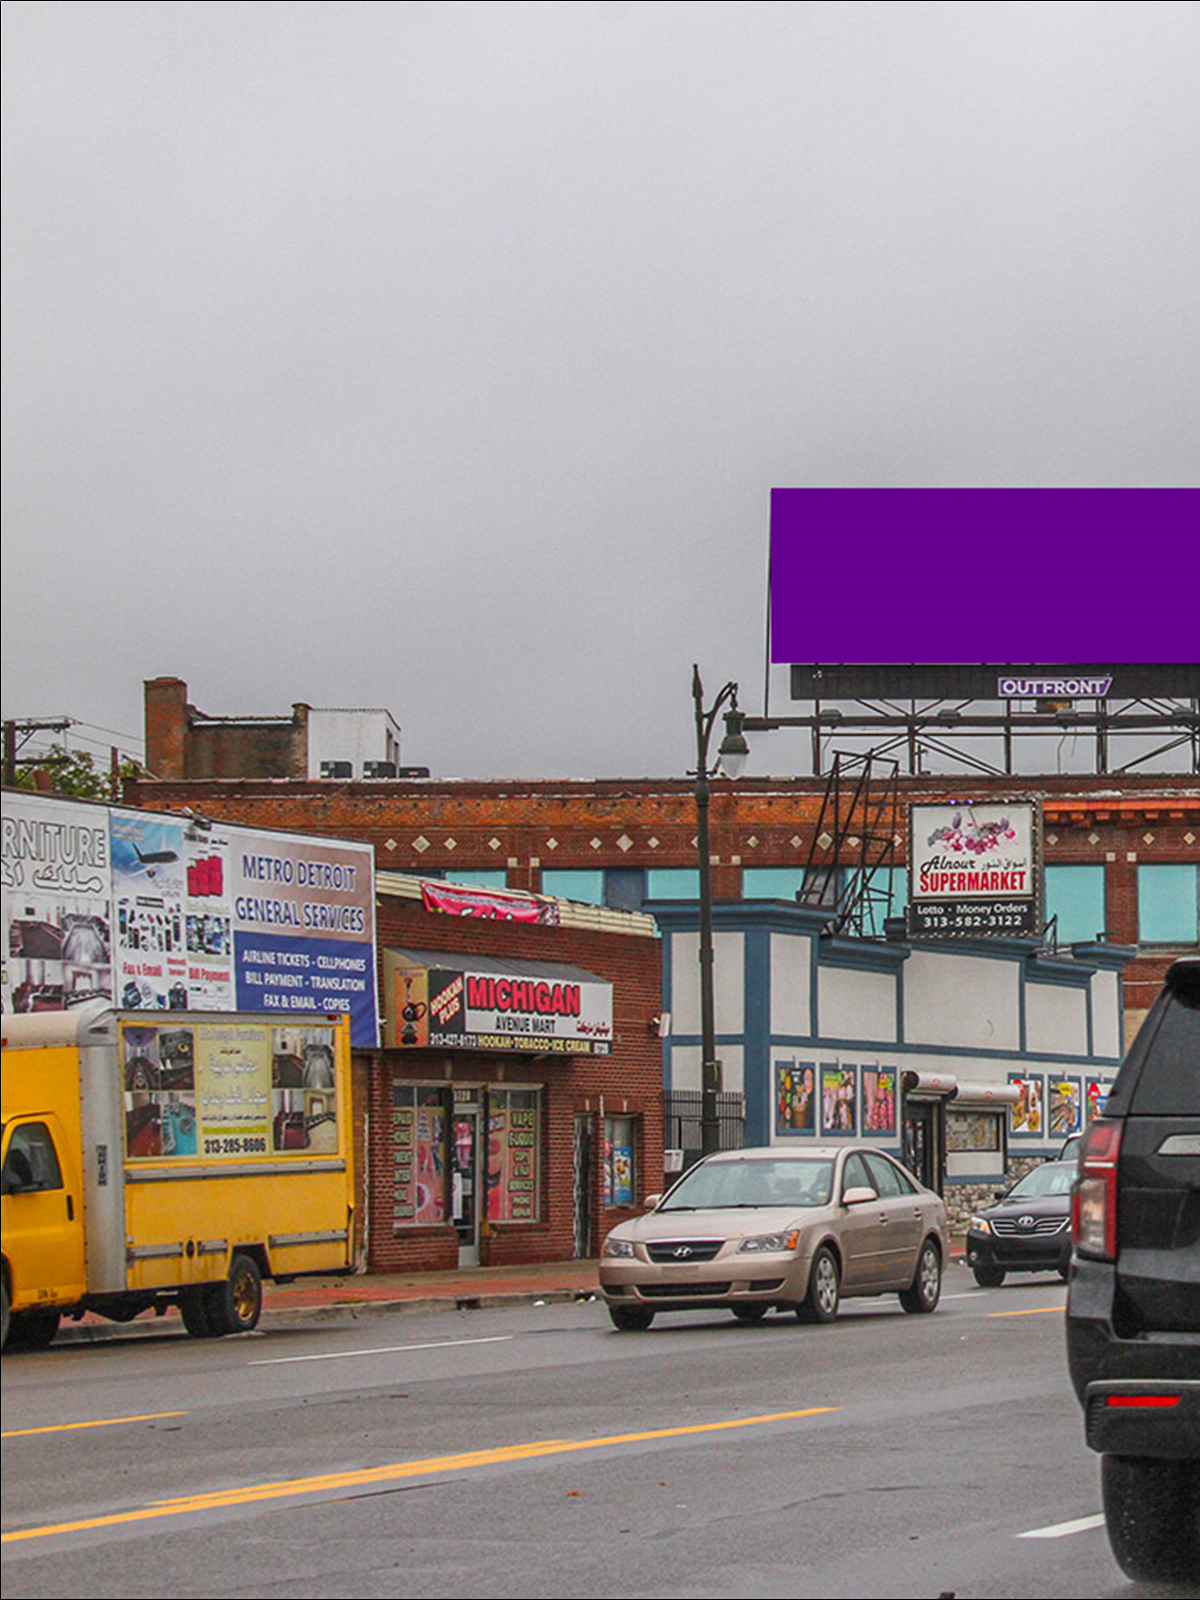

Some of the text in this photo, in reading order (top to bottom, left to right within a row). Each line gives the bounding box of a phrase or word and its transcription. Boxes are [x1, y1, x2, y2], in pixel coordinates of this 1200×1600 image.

[1002, 680, 1105, 694] OUTFRONT
[242, 854, 356, 890] METRO DETROIT
[919, 870, 1027, 892] SUPERMARKET
[235, 896, 301, 927] GENERAL
[302, 903, 365, 932] SERVICES
[917, 903, 1028, 915] Lotto Money Orders
[923, 915, 1022, 928] 313-582-3122
[242, 949, 276, 965] AIRLINE
[276, 952, 310, 968] TICKETS
[316, 956, 366, 972] CELLPHONES
[245, 971, 263, 985] BILL
[264, 973, 303, 988] PAYMENT
[310, 976, 366, 991] TRANSLATION
[263, 993, 280, 1008] FAX
[281, 995, 290, 1008] &
[290, 996, 317, 1010] EMAIL
[322, 997, 350, 1012] COPIES
[429, 976, 464, 1017] HOOKAH
[466, 975, 581, 1018] MICHIGAN
[438, 996, 461, 1026] PLUS
[495, 1016, 556, 1034] AVENUE MART
[477, 1035, 511, 1049] HOOKAH
[513, 1037, 549, 1051] TOBACCO
[551, 1039, 564, 1052] ICE
[565, 1040, 591, 1054] CREAM
[511, 1112, 535, 1128] VAPE
